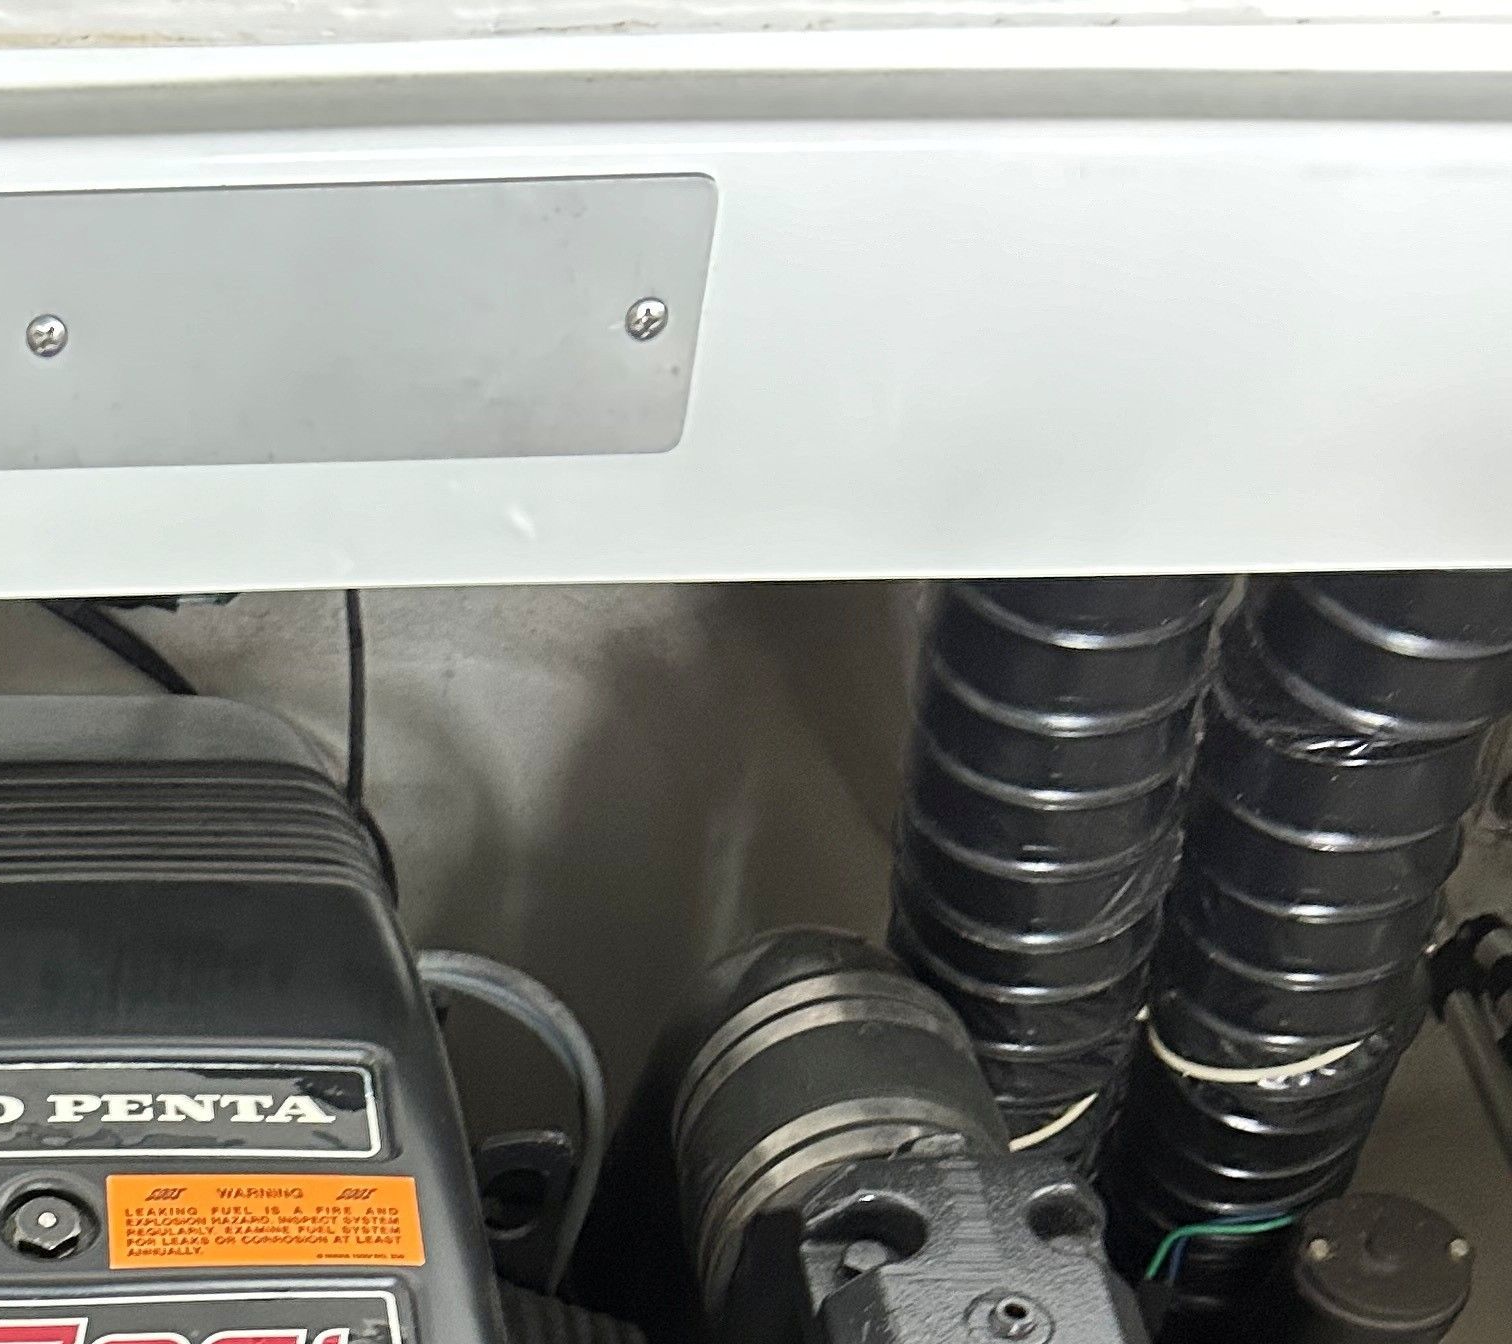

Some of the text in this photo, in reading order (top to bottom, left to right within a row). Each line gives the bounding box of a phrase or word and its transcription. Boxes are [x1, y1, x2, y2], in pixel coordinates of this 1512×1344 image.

[46, 1093, 336, 1124] PENTA
[216, 1187, 304, 1199] WARNING
[124, 1206, 399, 1217] LEAKING FUEL IS A FIRE AND
[125, 1216, 207, 1226] EXPLOSION
[278, 1216, 337, 1226] INSPECT
[342, 1216, 400, 1226] SYSTEM
[224, 1226, 290, 1236] EXAMINE
[297, 1226, 335, 1236] FUEL
[341, 1226, 401, 1236] SYSTEM
[126, 1236, 402, 1245] FOR LEAKS OR CORROSION AT LEAST
